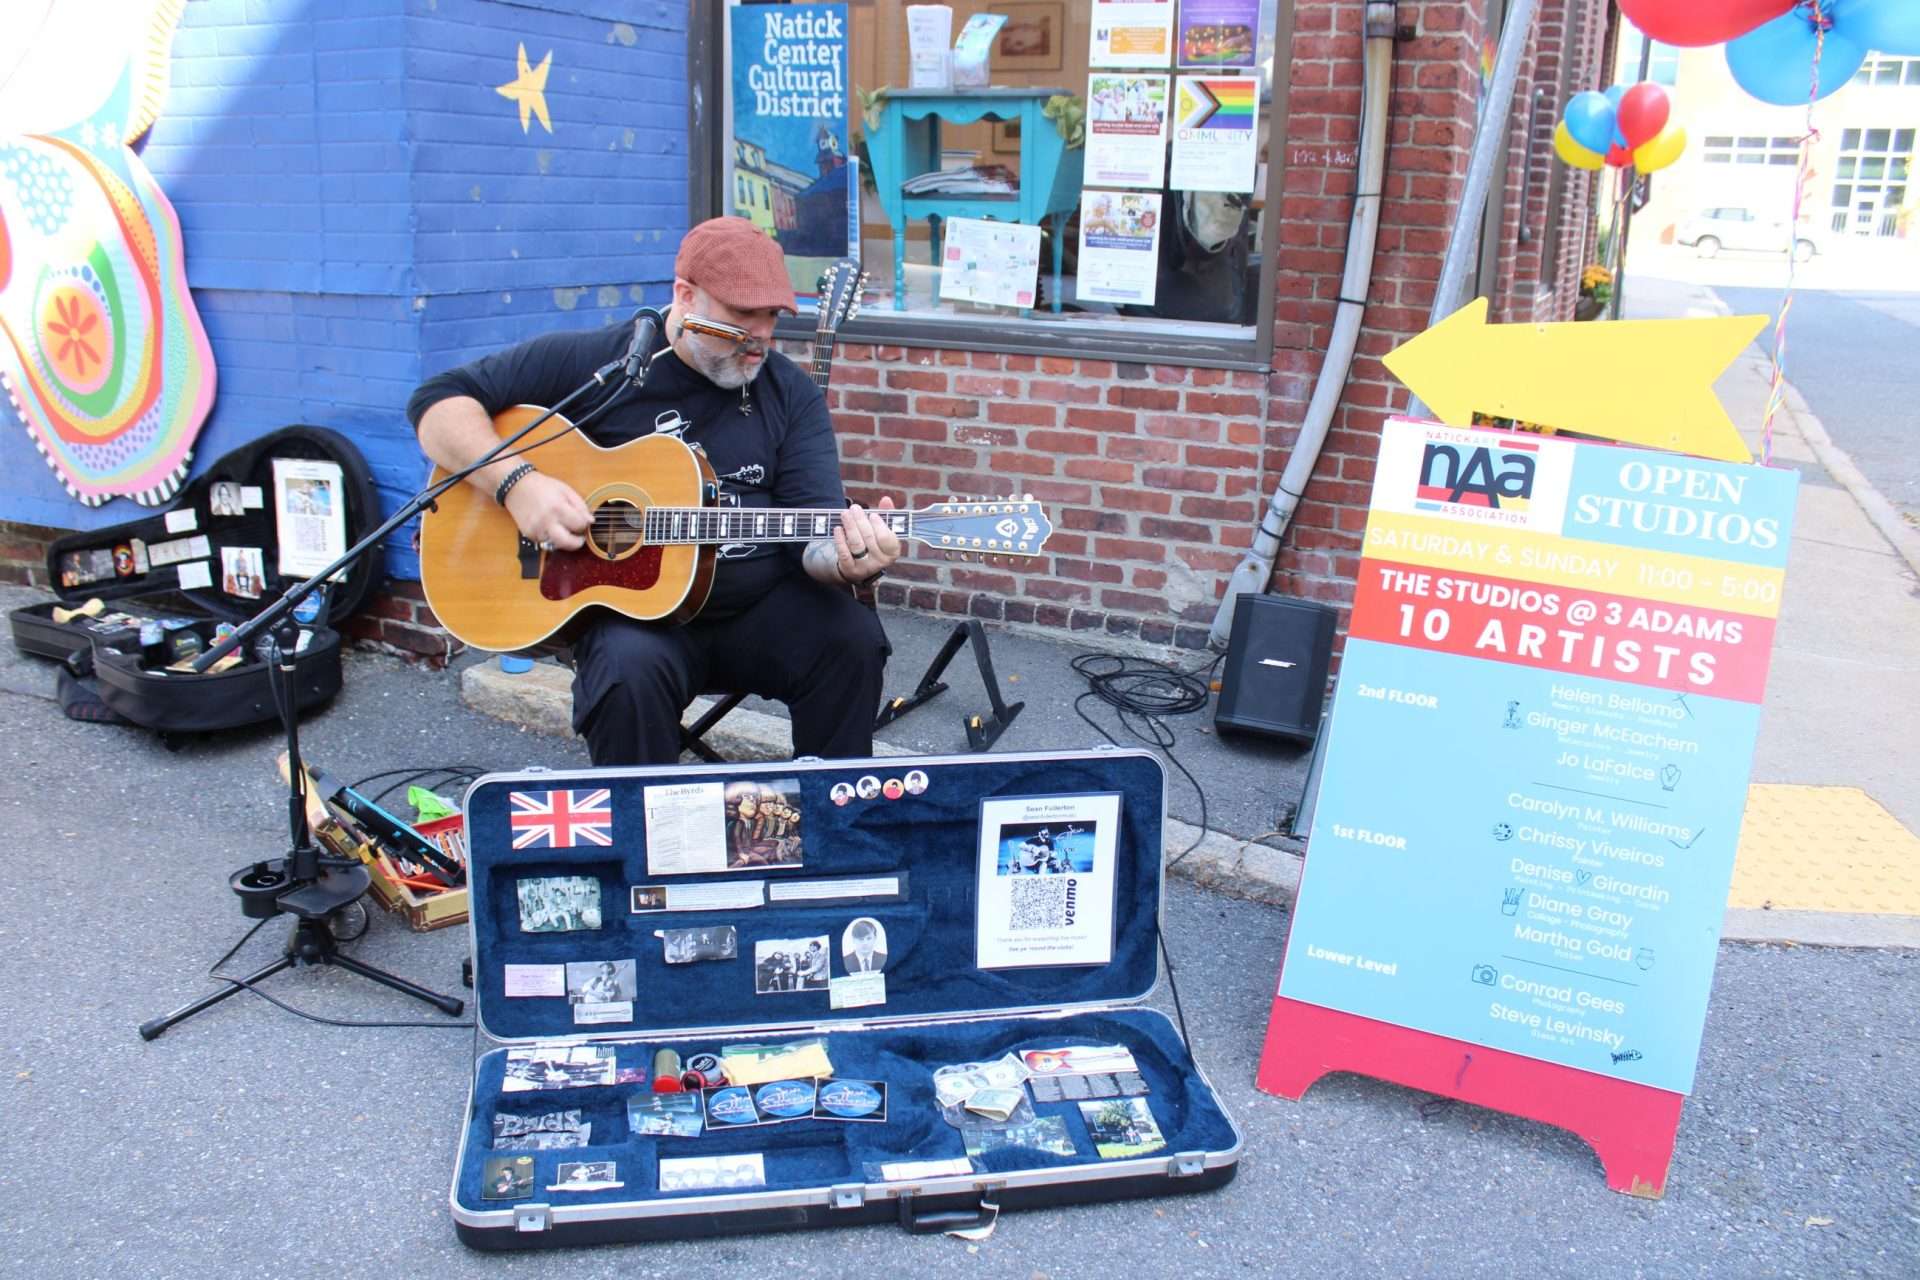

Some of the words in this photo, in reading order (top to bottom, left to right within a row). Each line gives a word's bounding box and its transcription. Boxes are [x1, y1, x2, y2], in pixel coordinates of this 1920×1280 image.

[764, 10, 842, 39] Natick
[764, 39, 842, 65] Center
[749, 64, 843, 92] Cultural
[756, 91, 843, 118] District
[1426, 430, 1471, 444] NATICK
[1619, 461, 1748, 504] OPEN
[1441, 505, 1527, 524] ASSOCIATION
[1573, 494, 1780, 549] STUDIOS
[1371, 527, 1489, 562] SATURDAY
[1495, 546, 1513, 564] &
[1519, 549, 1620, 578] SUNDAY
[1638, 563, 1694, 591] 11:00
[1720, 575, 1776, 603] 5:00
[1380, 568, 1431, 597] THE
[1436, 577, 1560, 616] STUDIOS
[1566, 600, 1597, 627] @
[1604, 602, 1623, 625] 3
[1627, 607, 1743, 644] ADAMS
[1400, 603, 1451, 642] 10
[1475, 618, 1716, 685] ARTISTS
[1358, 684, 1384, 700] 2nd
[1388, 688, 1438, 708] FLOOR
[1551, 683, 1604, 706] Helen
[1608, 693, 1687, 721] Bellomo
[1527, 711, 1588, 736] Ginger
[1593, 722, 1698, 753] McEachern
[1557, 751, 1580, 768] Jo
[1584, 754, 1656, 782] LaFalce
[1508, 792, 1580, 820] Carolyn
[1585, 808, 1605, 825] M.
[1611, 811, 1692, 841] Williams
[1333, 824, 1355, 841] 1st
[1357, 829, 1407, 852] FLOOR
[1519, 826, 1586, 857] Chrissy
[1591, 839, 1665, 868] Viveiros
[1511, 858, 1574, 883] Denise
[1593, 874, 1670, 904] Girardin
[1064, 878, 1077, 927] venmo
[1528, 893, 1583, 917] Diane
[1587, 904, 1633, 930] Gray
[1307, 943, 1353, 965] Lower
[1355, 950, 1398, 977] Level
[1514, 924, 1582, 952] Martha
[1586, 939, 1633, 962] Gold
[1501, 974, 1572, 1003] Conrad
[1576, 991, 1626, 1016] Gees
[1489, 1002, 1542, 1028] Steve
[1546, 1016, 1624, 1050] Levinsky
